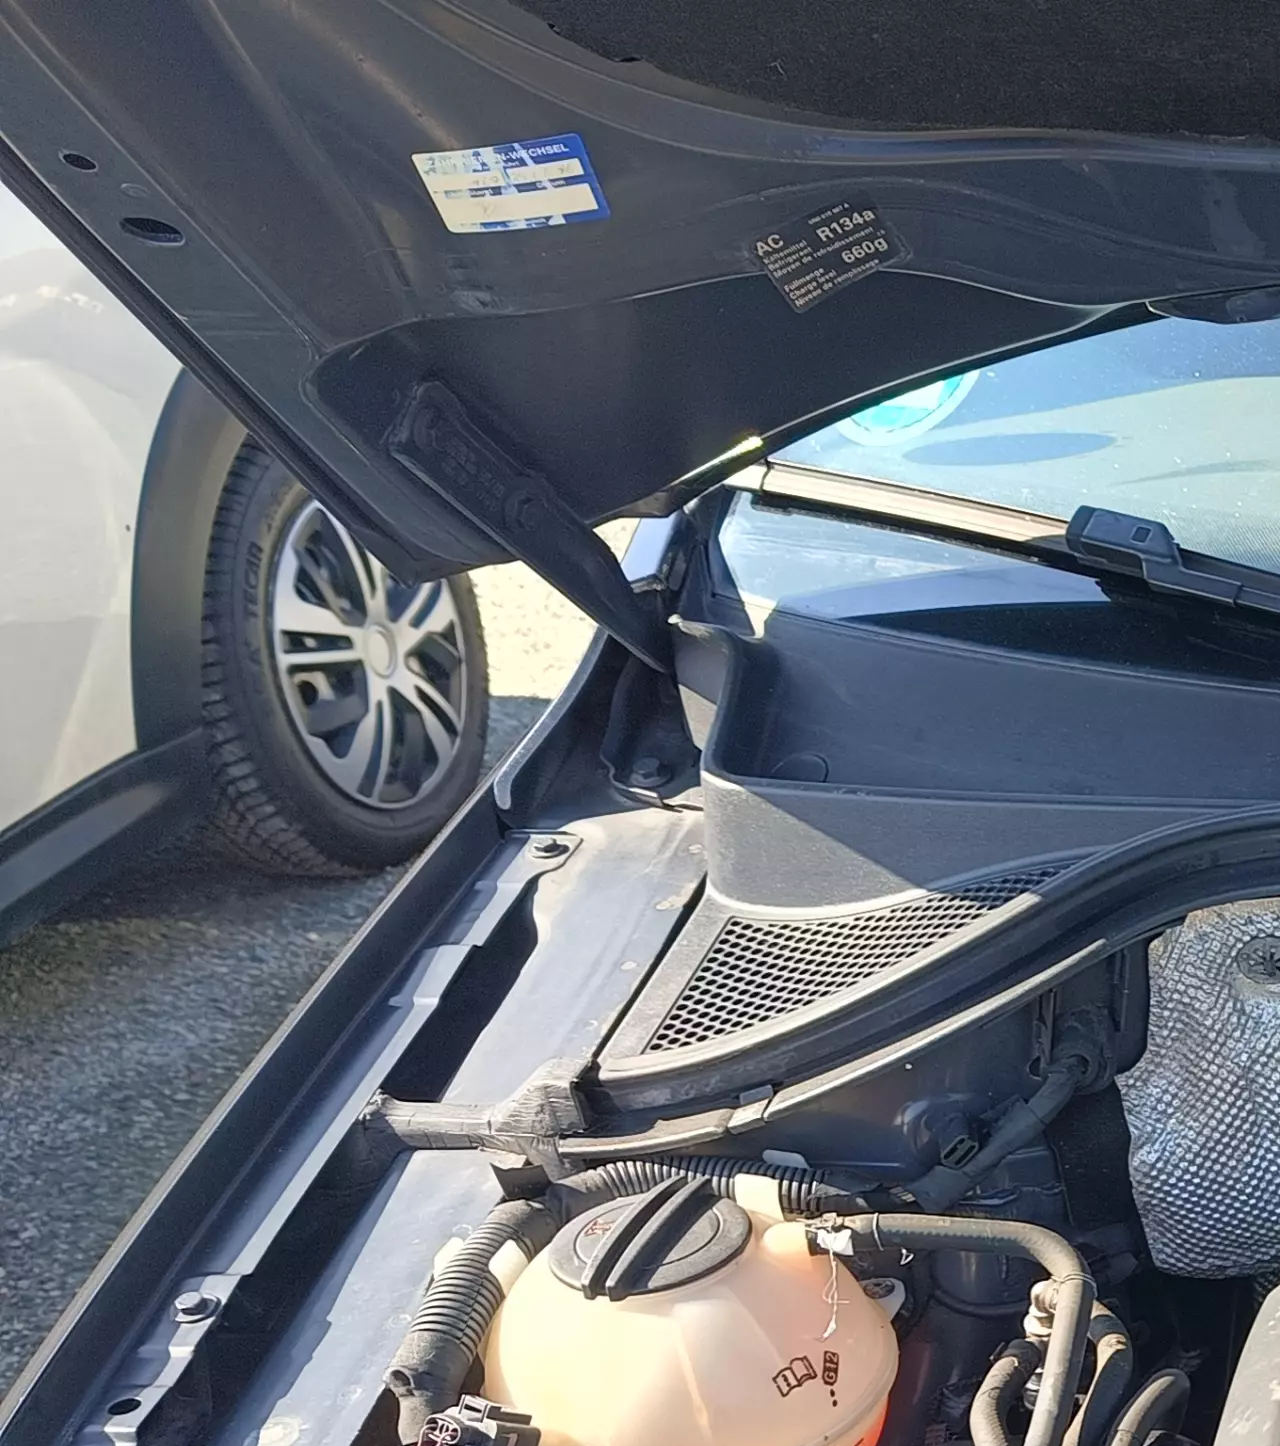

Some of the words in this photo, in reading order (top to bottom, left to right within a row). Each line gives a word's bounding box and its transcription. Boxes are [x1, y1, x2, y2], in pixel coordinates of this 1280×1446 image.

[816, 210, 875, 242] R134a
[755, 234, 784, 256] AC
[841, 237, 889, 264] 660g
[788, 279, 818, 300] Charge
[823, 1351, 839, 1384] G12
